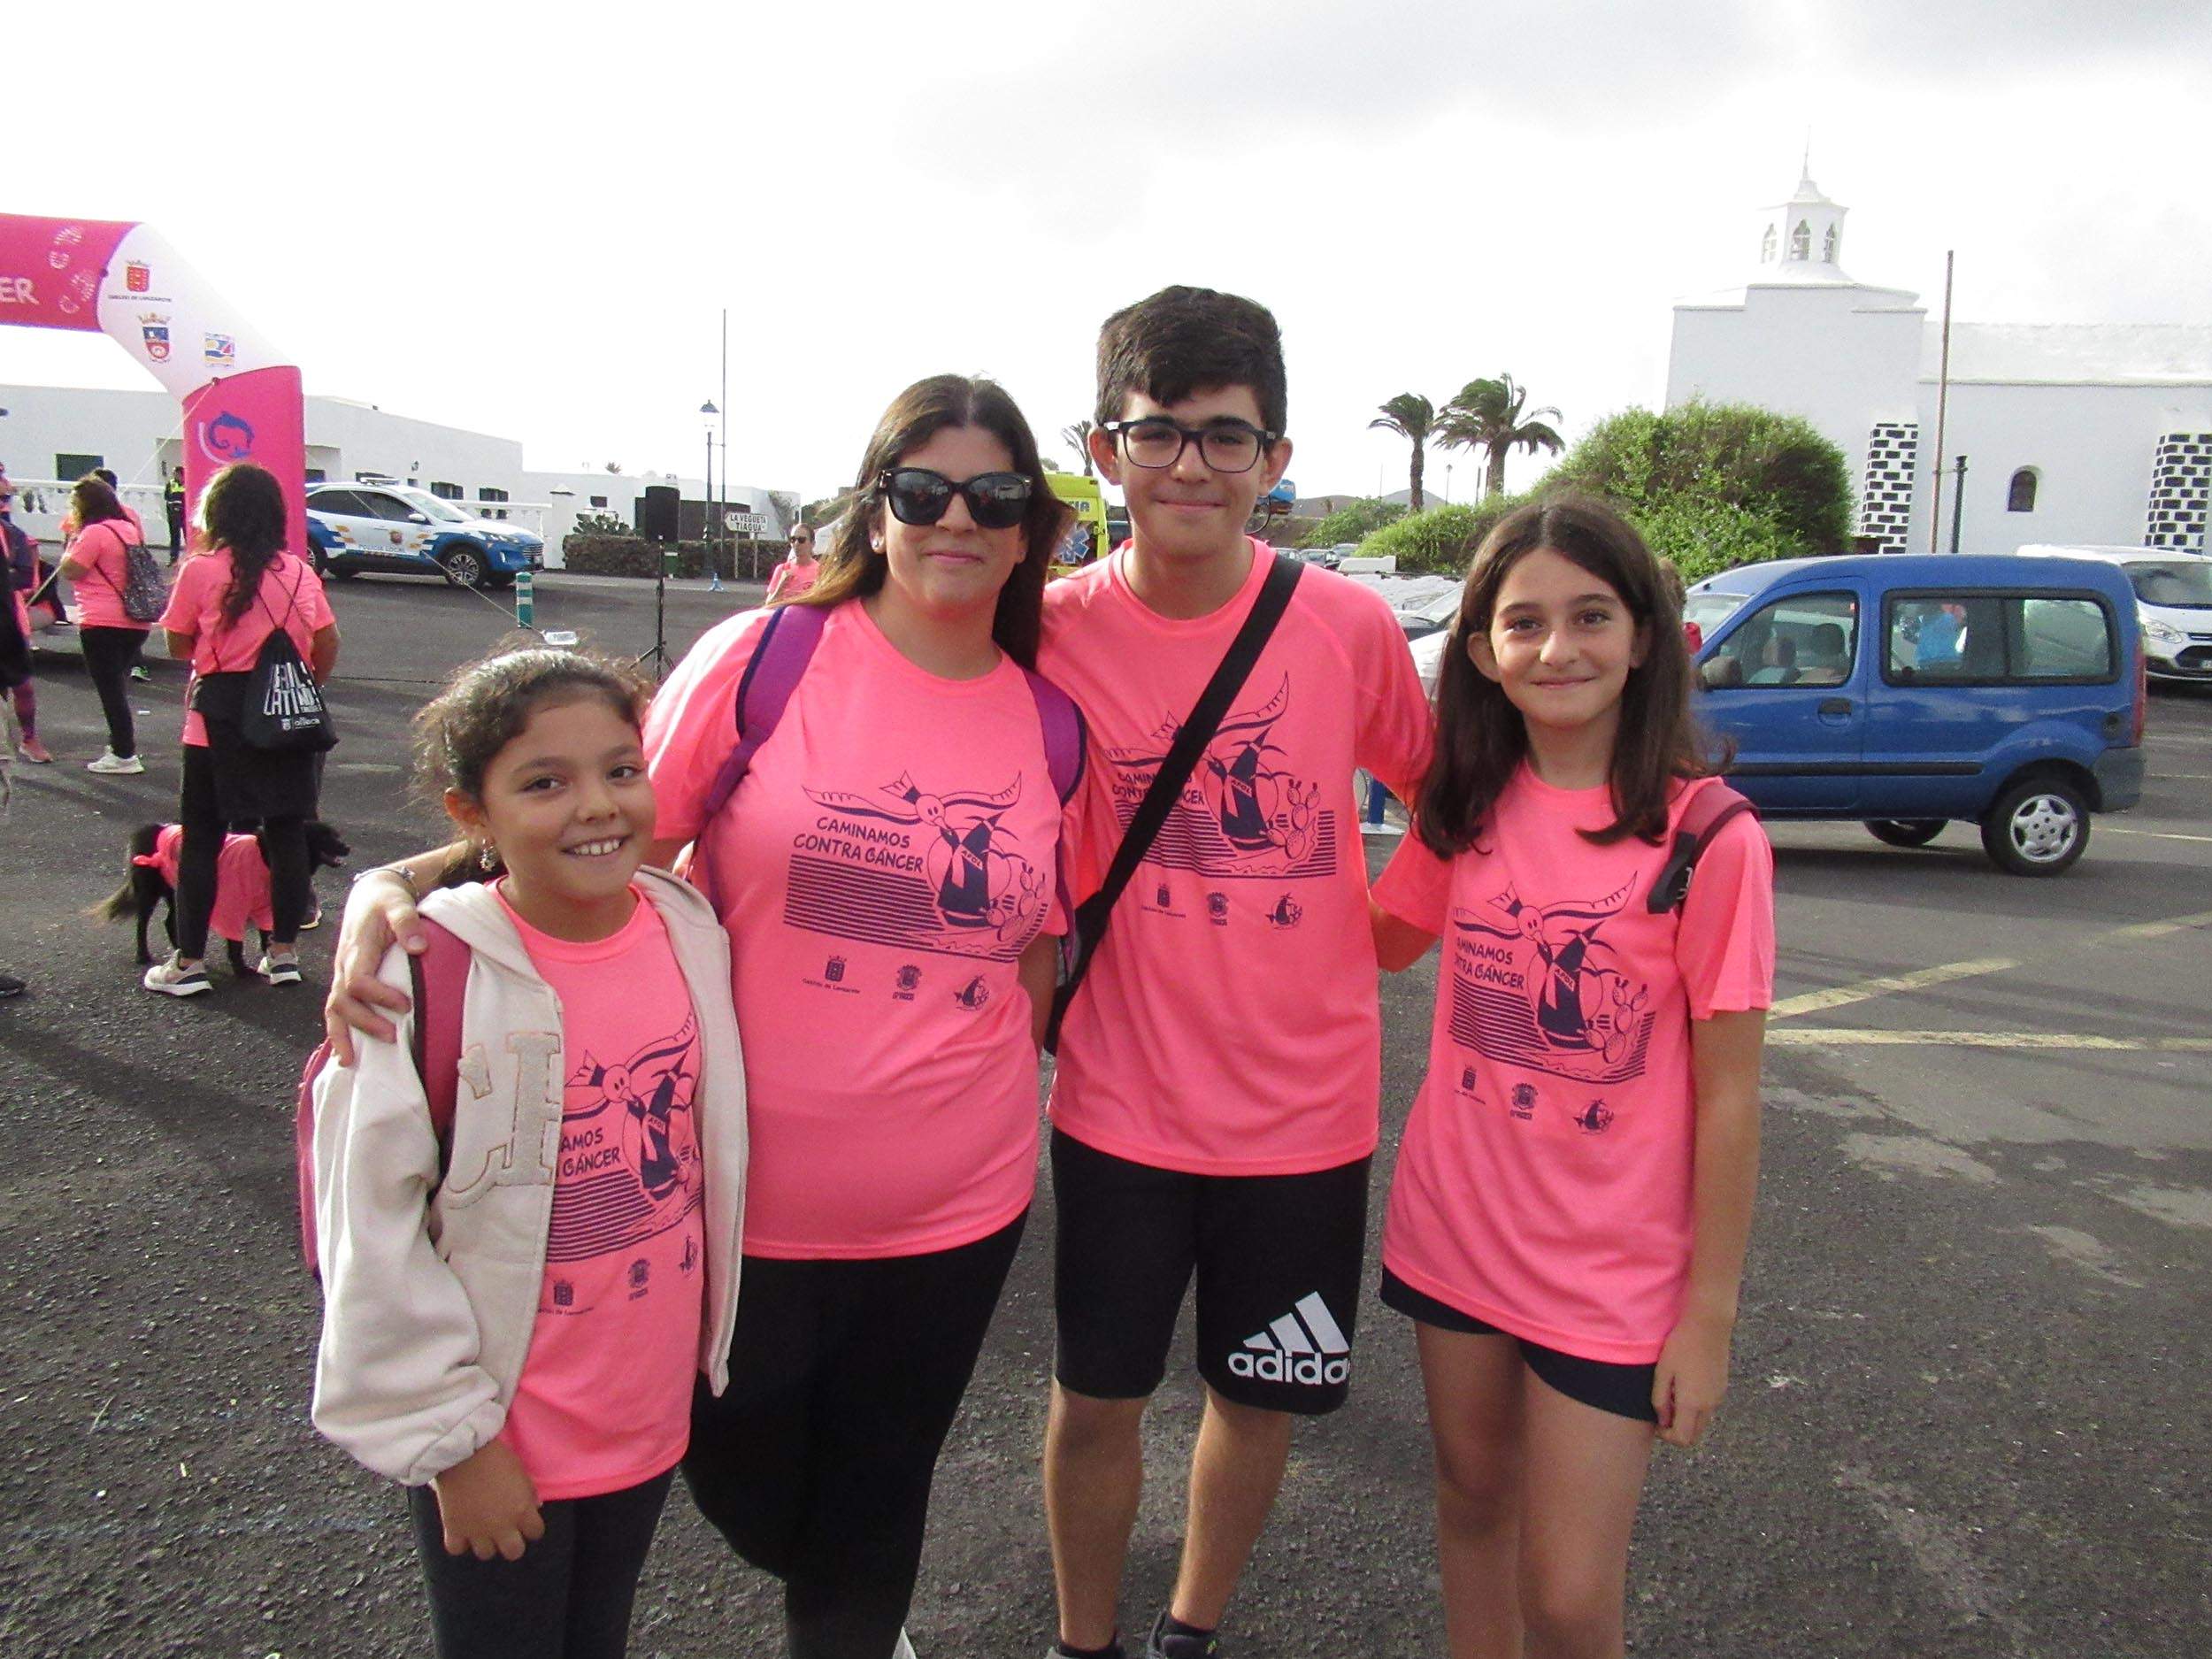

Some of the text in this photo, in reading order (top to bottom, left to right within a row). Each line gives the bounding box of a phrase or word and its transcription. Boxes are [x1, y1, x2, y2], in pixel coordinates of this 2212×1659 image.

[736, 522, 762, 532] TIAGUA
[740, 514, 766, 524] VEGUETA
[793, 833, 861, 860] CONTRA
[817, 817, 910, 849] CAMINAMOS
[1227, 1348, 1351, 1386] adida
